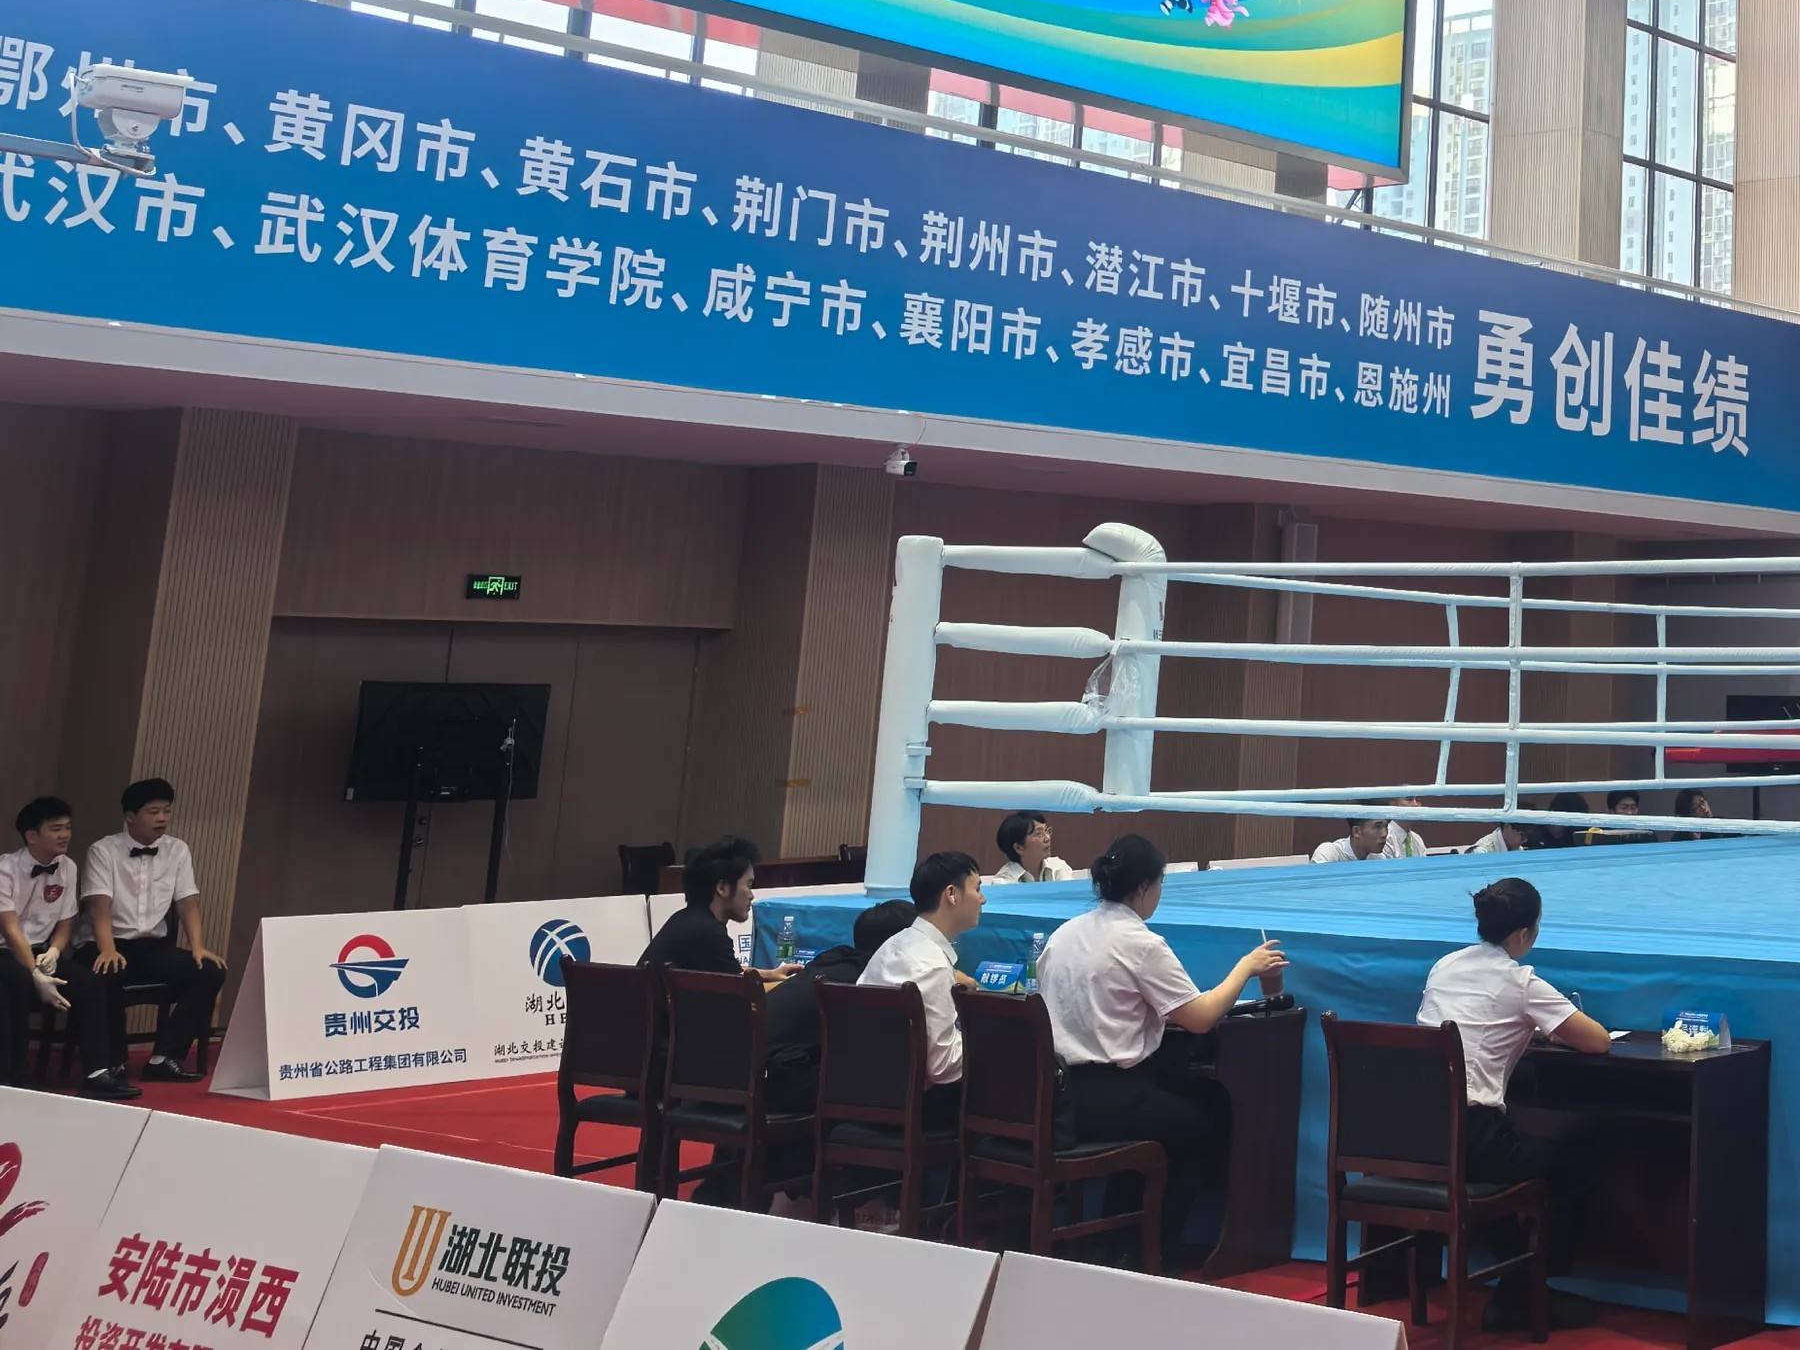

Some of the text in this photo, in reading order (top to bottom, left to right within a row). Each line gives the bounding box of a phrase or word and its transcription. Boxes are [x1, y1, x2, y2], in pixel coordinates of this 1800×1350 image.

[1470, 309, 1749, 457] 勇创佳绩
[324, 1006, 420, 1038] 贵州交投
[278, 1048, 468, 1081] 贵州省公路工程集团有限公司
[98, 1233, 300, 1339] 安陆市涢西
[438, 1224, 571, 1297] 湖北联投
[432, 1277, 556, 1318] HUBEI UNITED INVESTMENT
